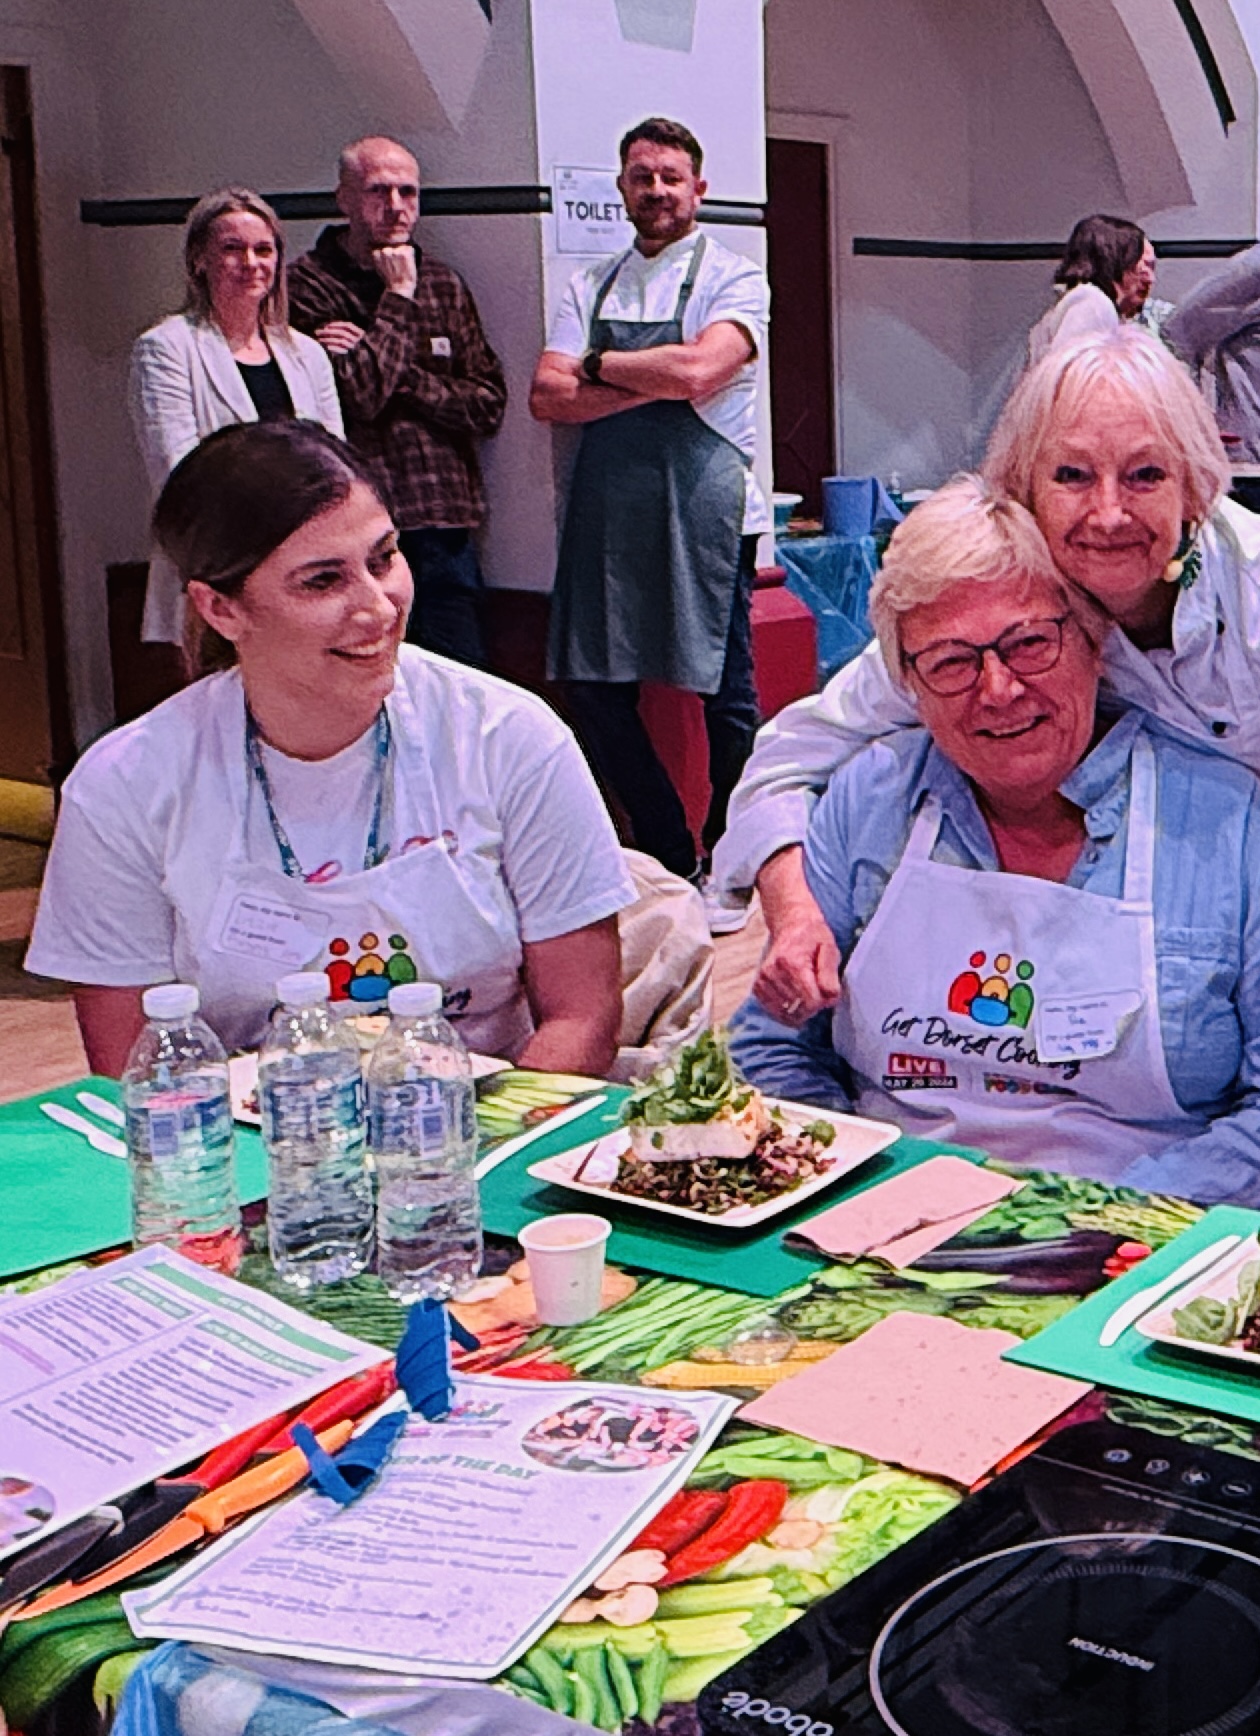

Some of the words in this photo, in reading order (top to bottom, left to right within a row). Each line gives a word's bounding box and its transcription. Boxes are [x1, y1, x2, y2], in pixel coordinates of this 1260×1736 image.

[564, 200, 631, 223] TOILET
[881, 1008, 923, 1038] Get
[923, 1016, 1000, 1056] Dorset
[891, 1056, 941, 1074] LIVE
[452, 1454, 497, 1472] THE
[493, 1462, 542, 1480] DAY
[1066, 1636, 1156, 1673] INDUCTION
